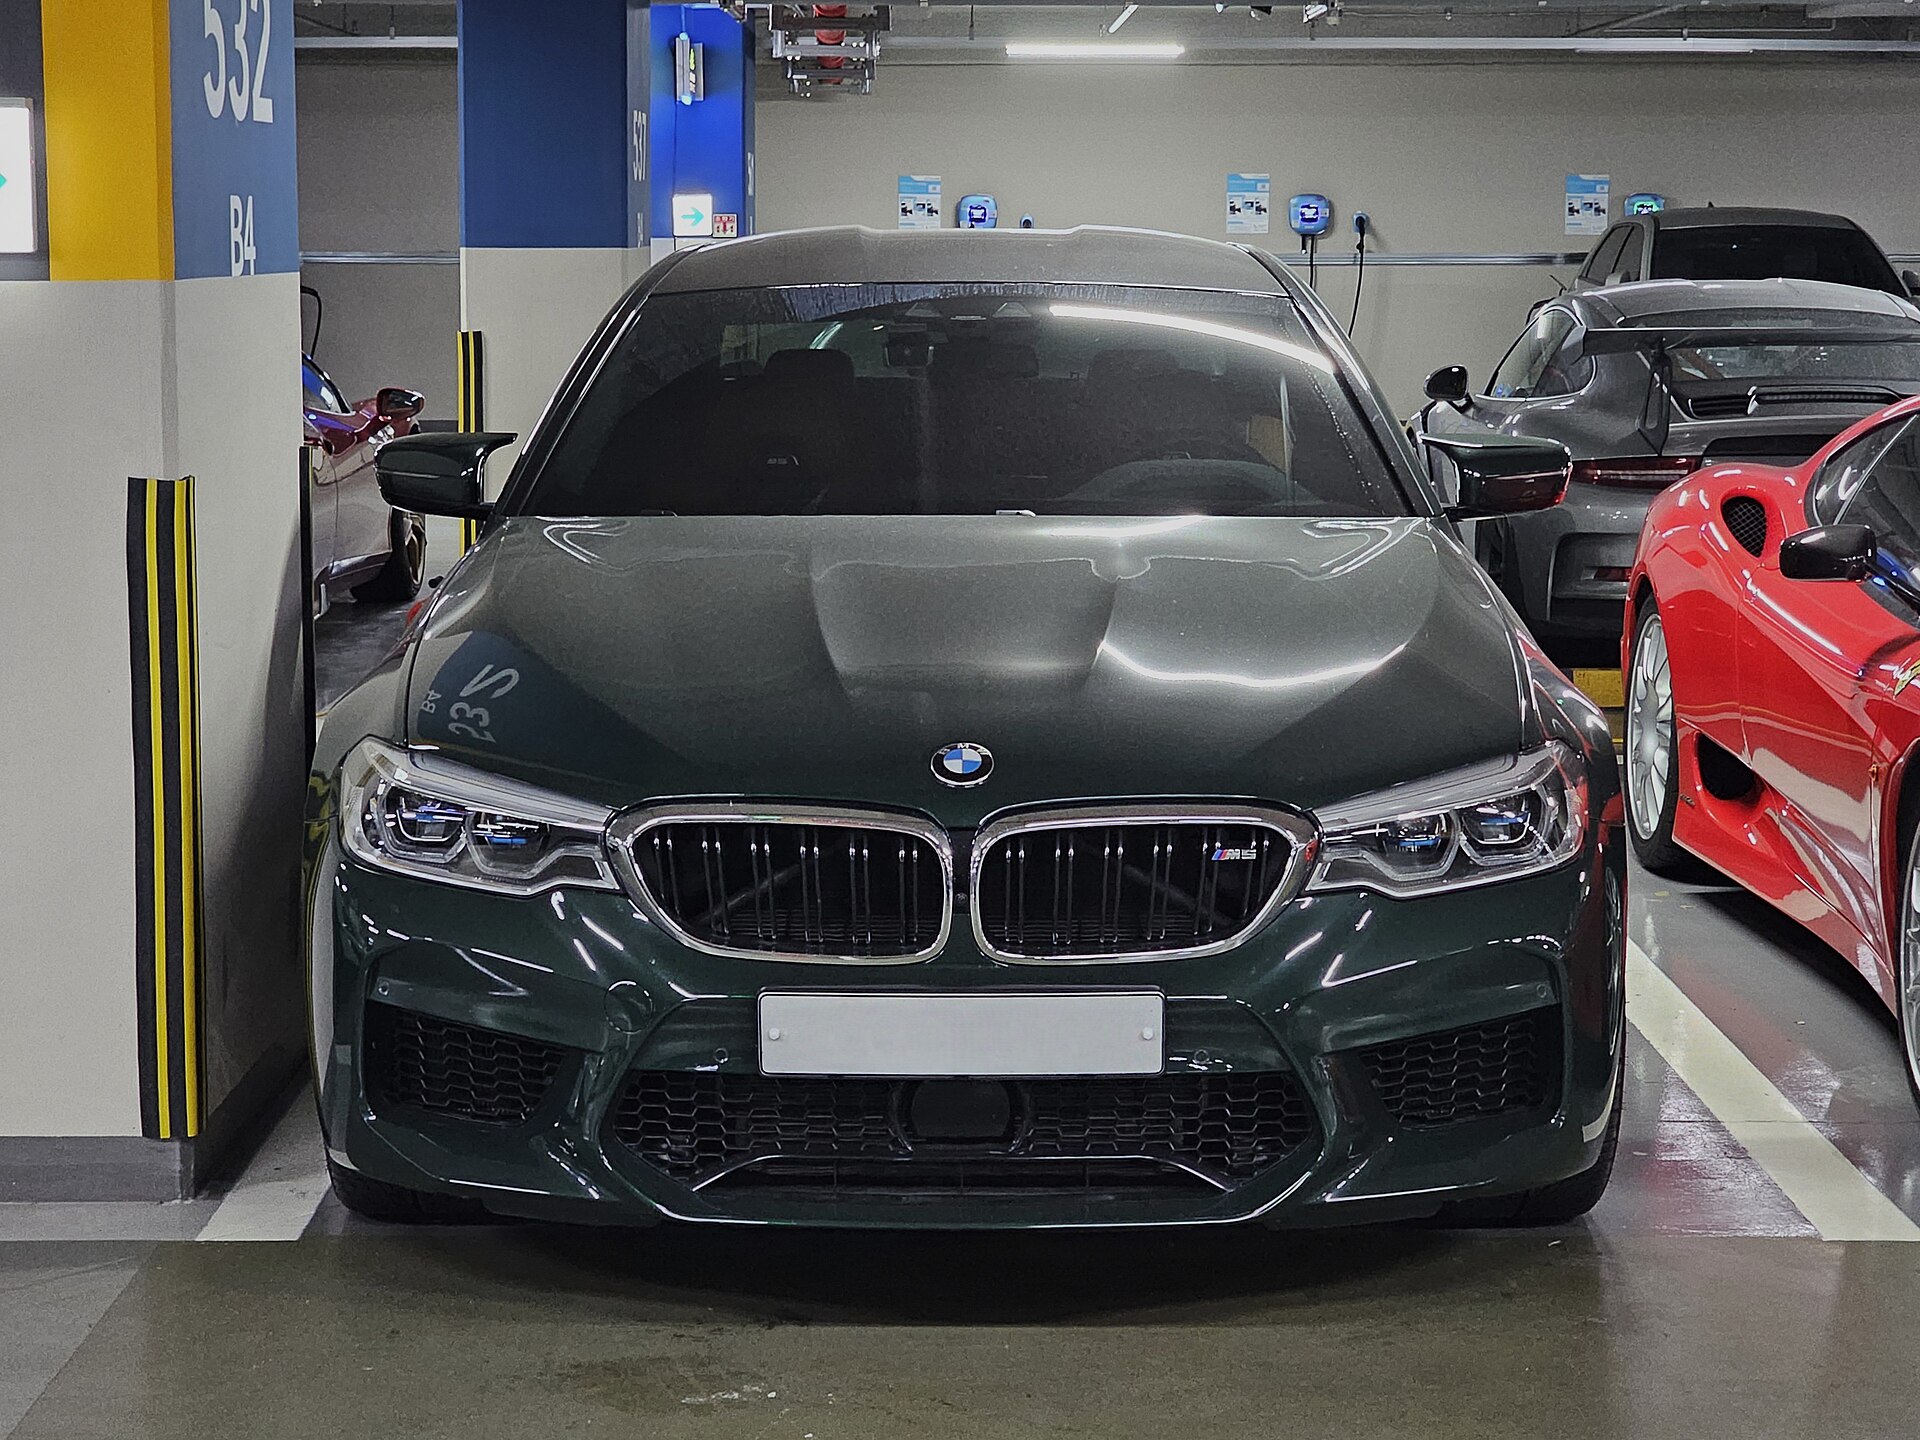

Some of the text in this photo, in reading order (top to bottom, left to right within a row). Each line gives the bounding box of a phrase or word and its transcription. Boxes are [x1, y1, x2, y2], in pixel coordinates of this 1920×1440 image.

[203, 0, 274, 124] 532
[632, 110, 647, 182] 537
[229, 194, 257, 277] B4
[1212, 848, 1257, 860] M5
